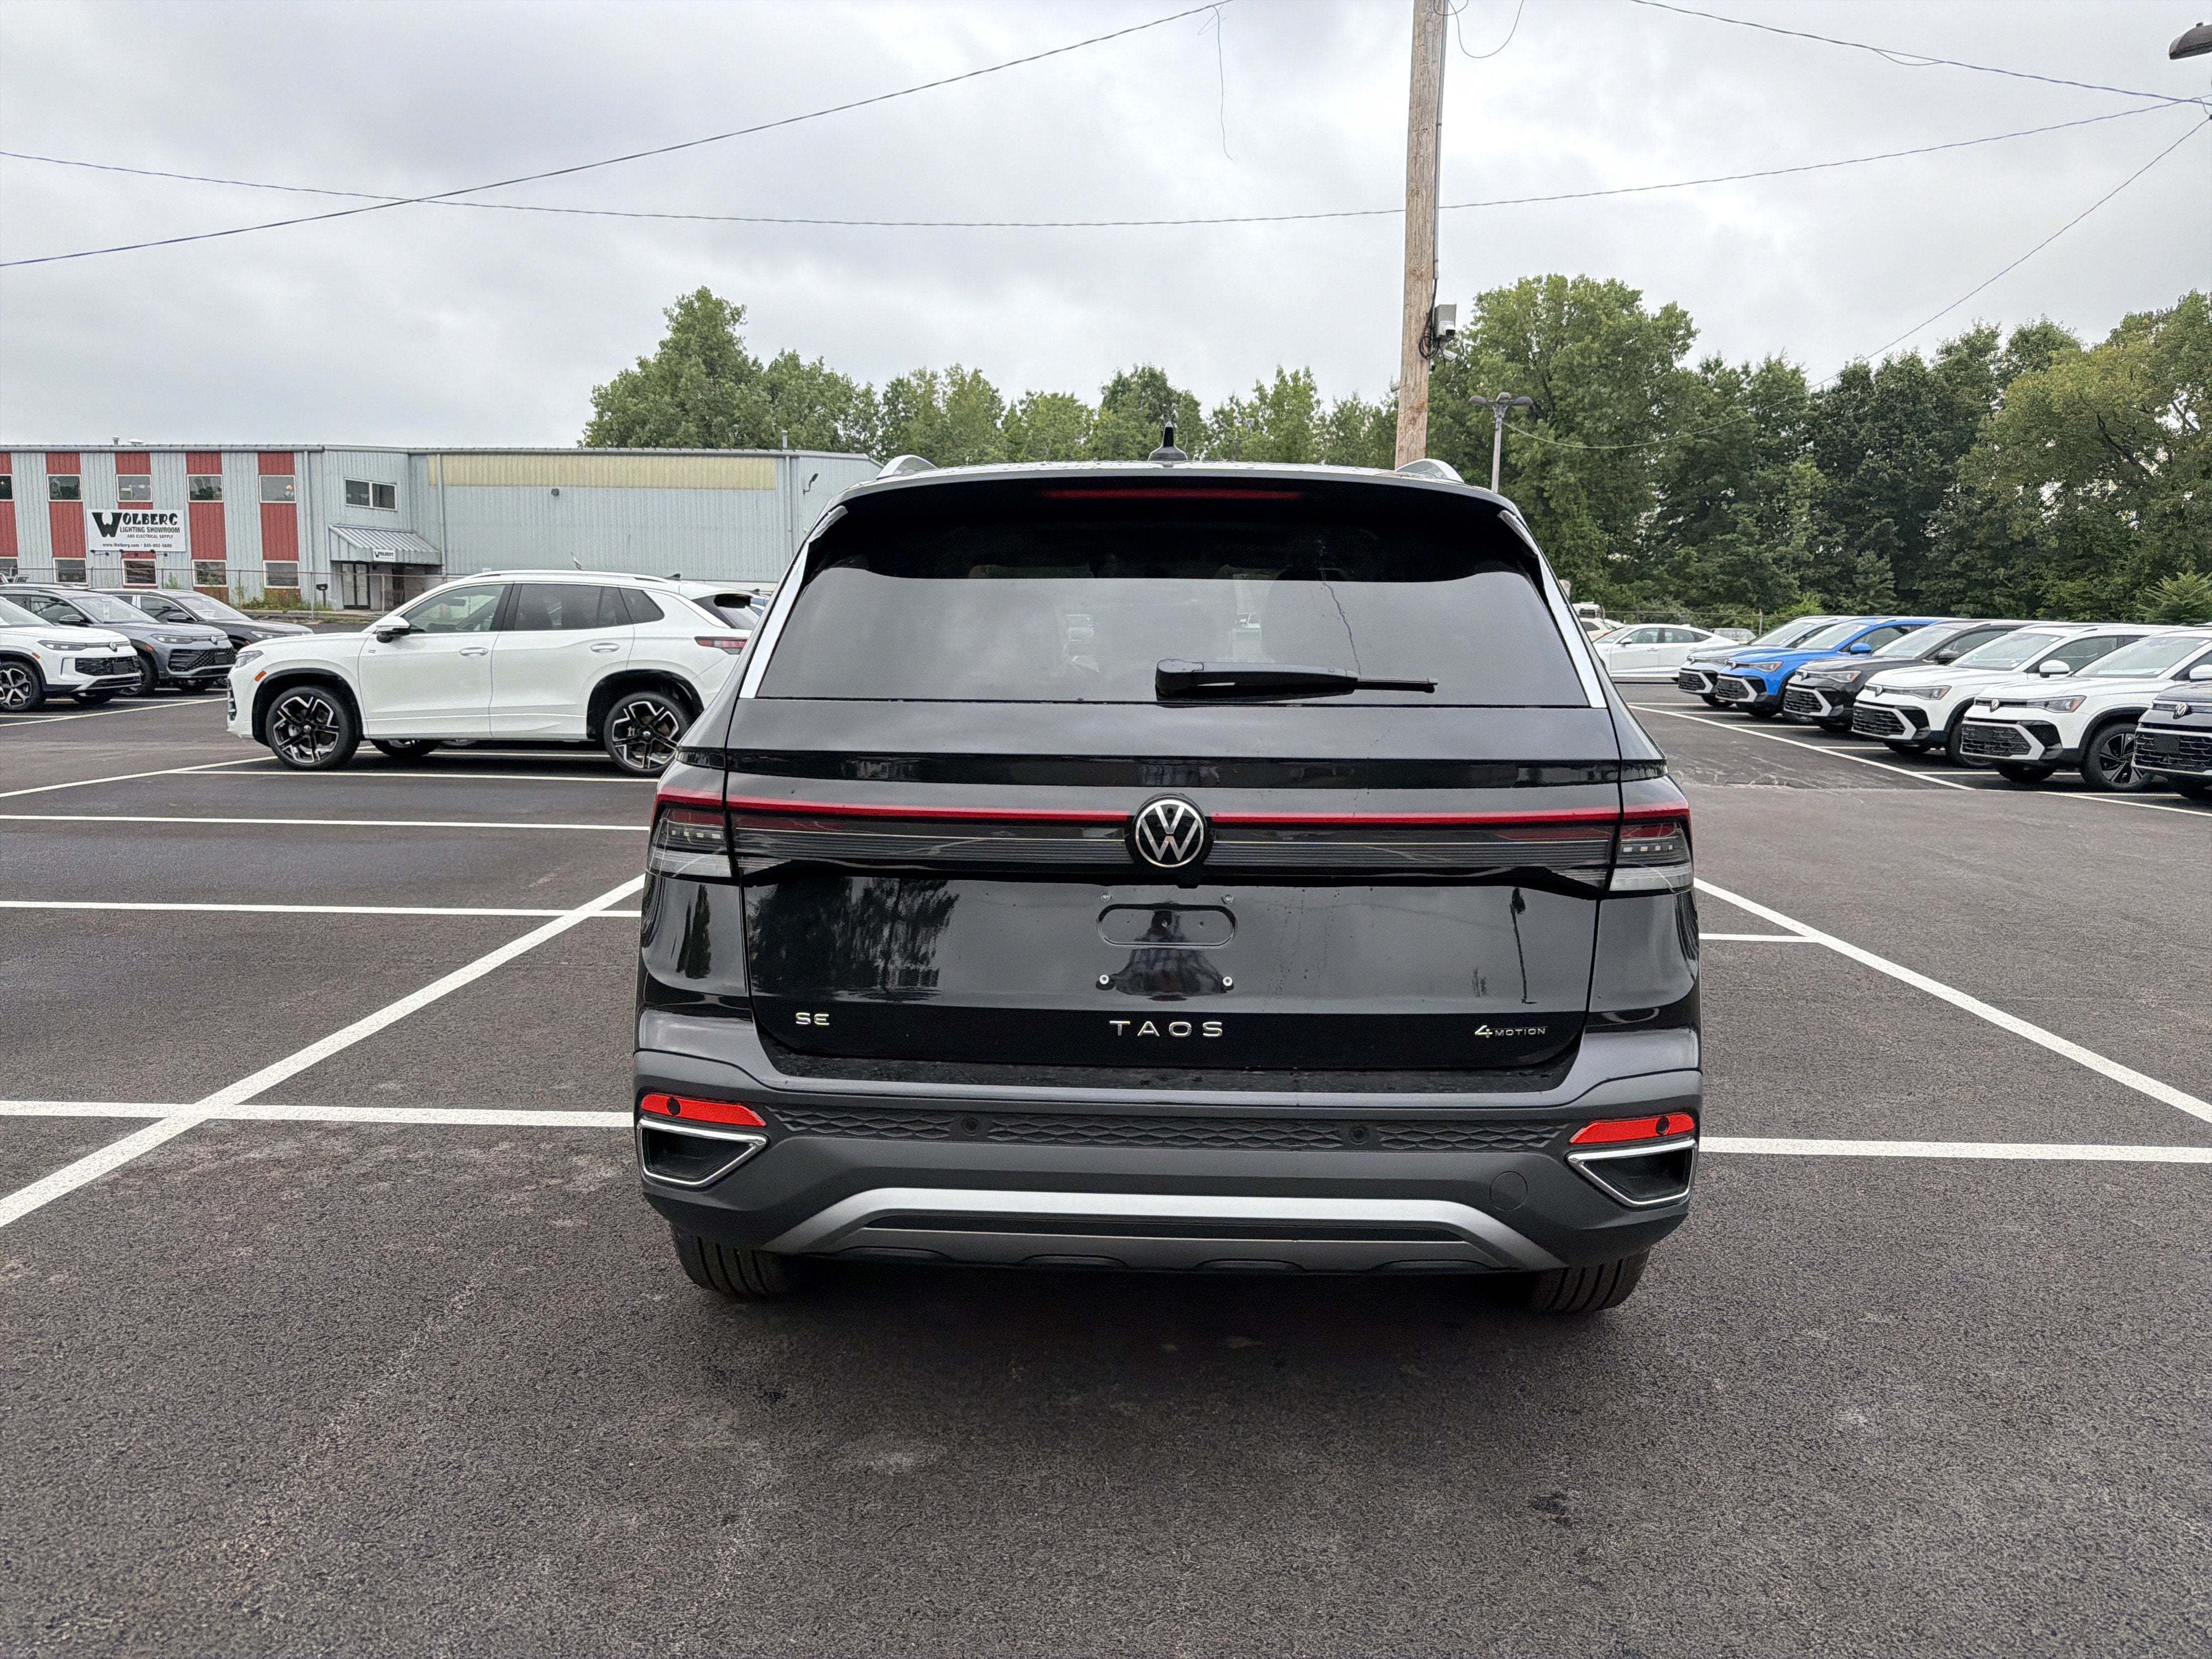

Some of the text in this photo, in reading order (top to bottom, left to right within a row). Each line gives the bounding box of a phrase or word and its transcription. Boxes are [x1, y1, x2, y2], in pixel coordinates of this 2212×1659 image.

[92, 512, 178, 538] WOLBERG
[795, 1012, 830, 1025] SE
[1109, 1020, 1223, 1037] TAOS
[1474, 1025, 1546, 1039] 4MOTION
